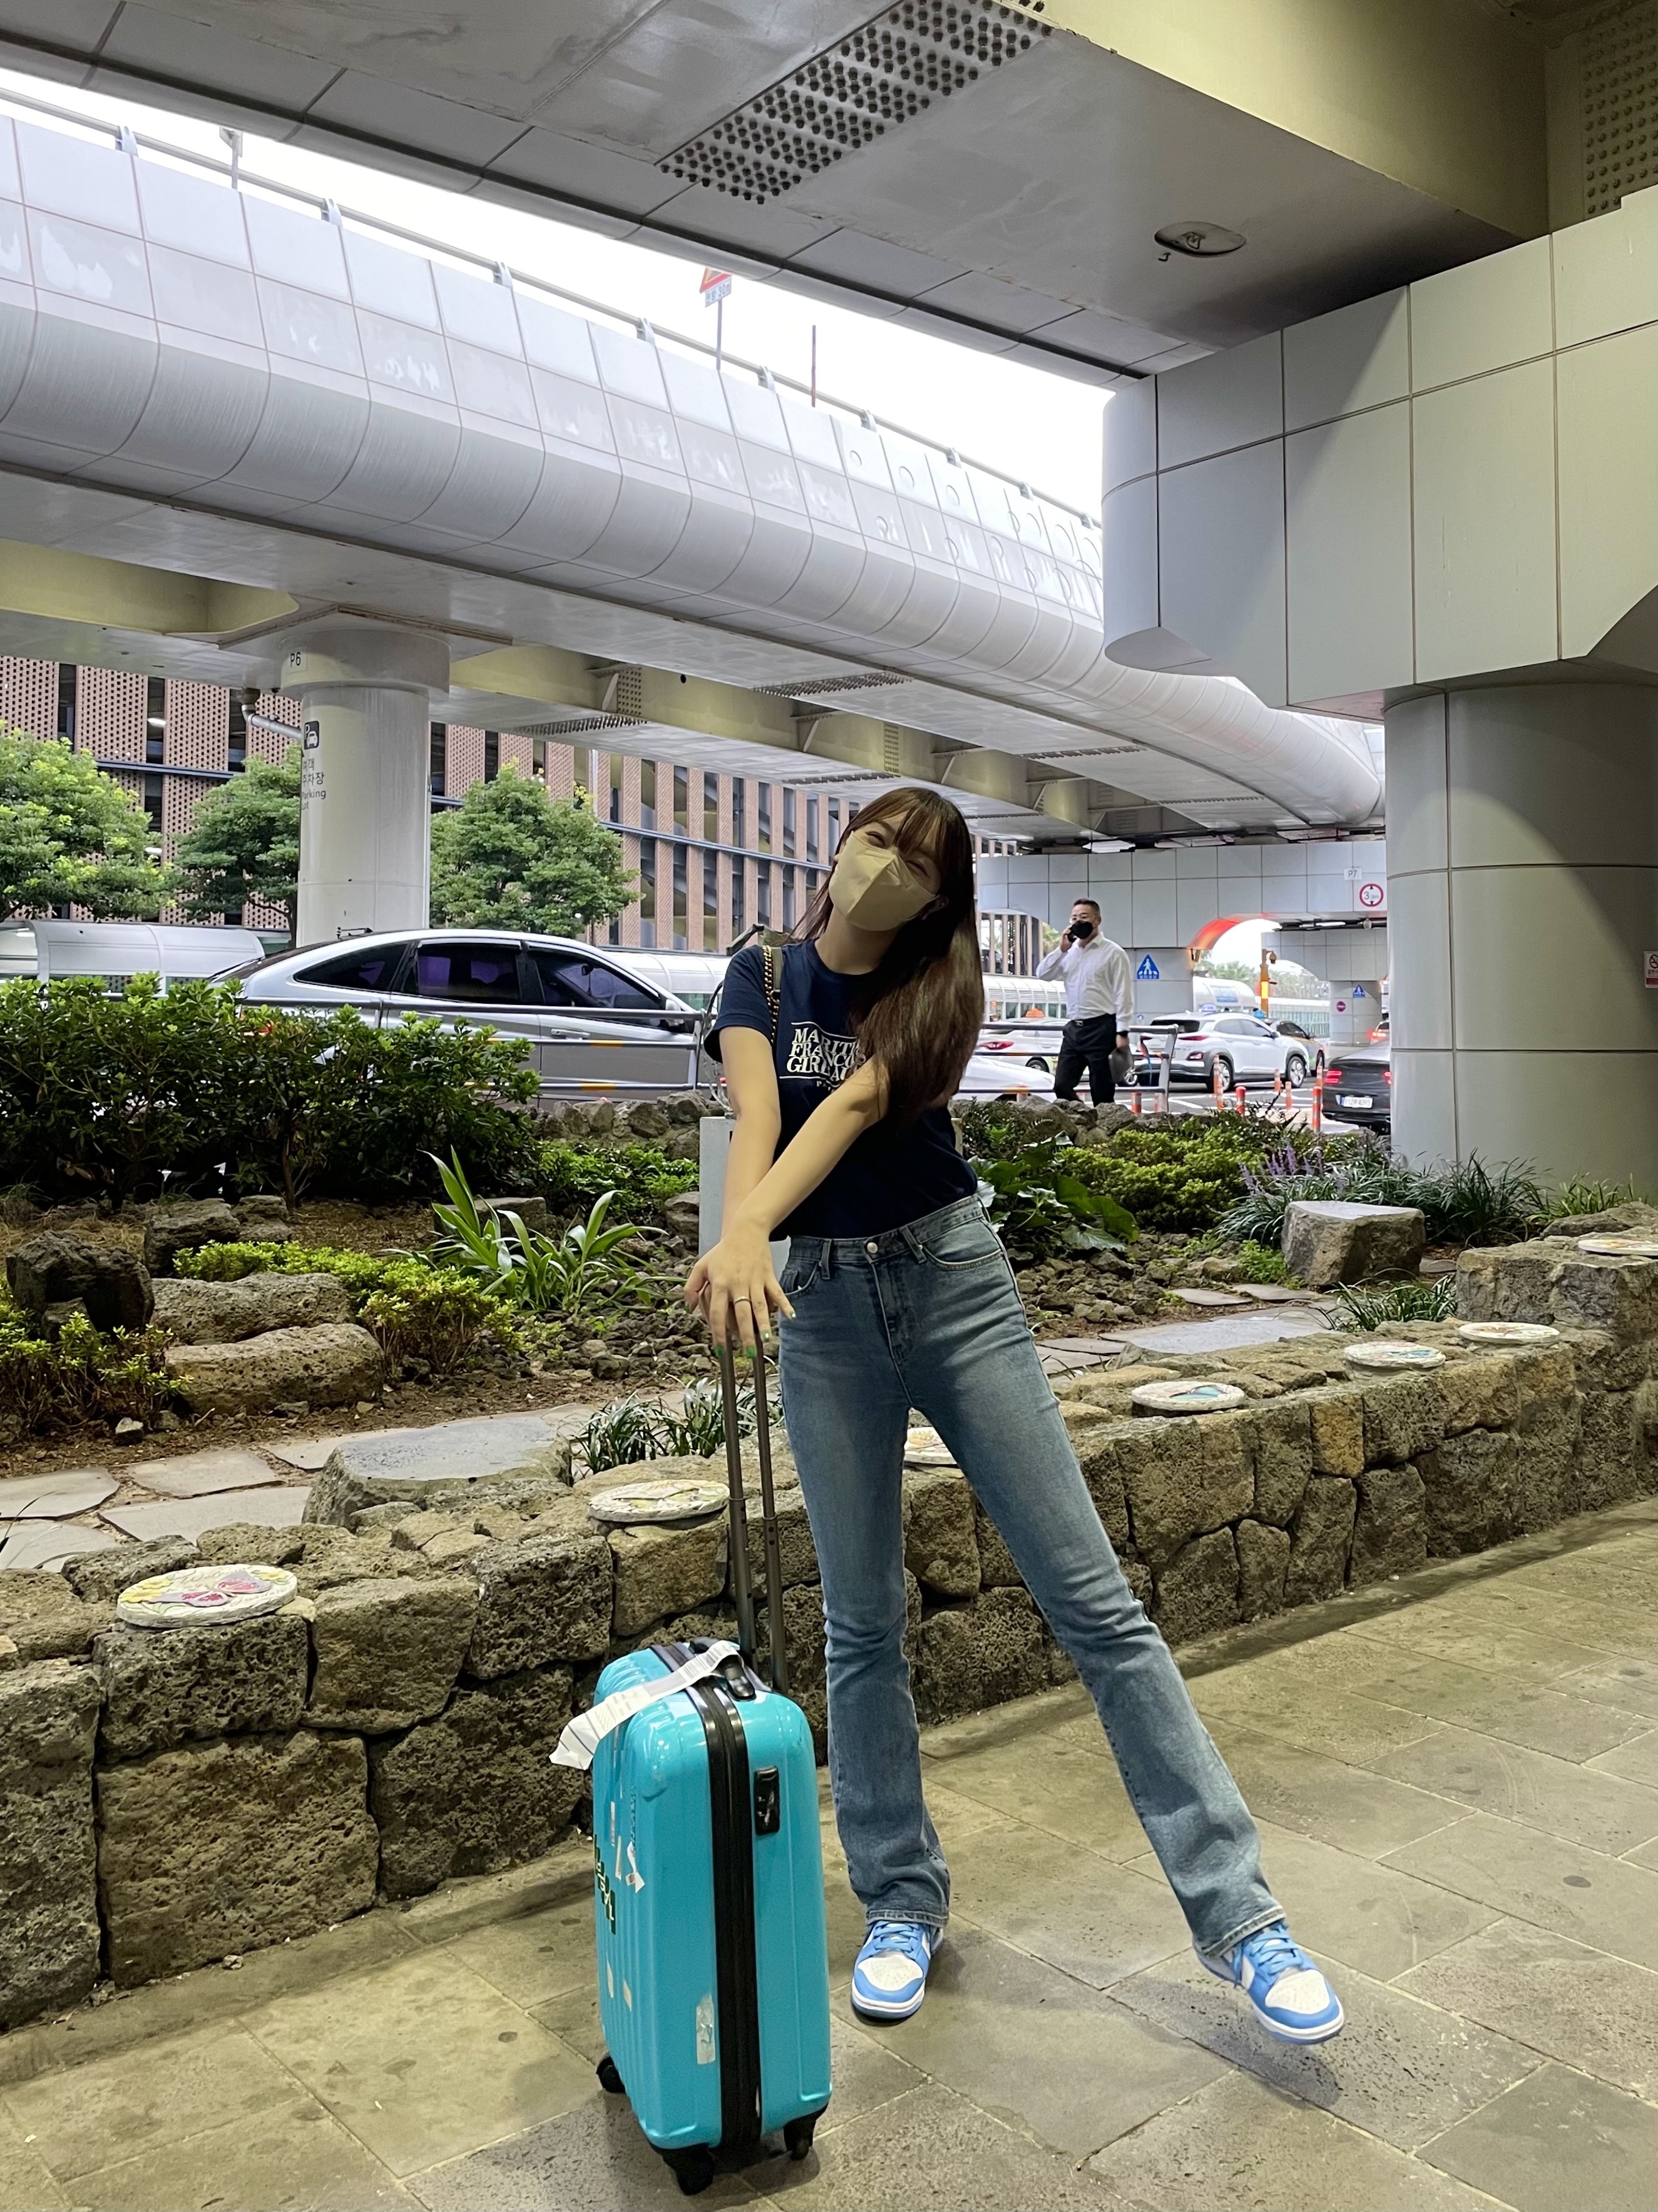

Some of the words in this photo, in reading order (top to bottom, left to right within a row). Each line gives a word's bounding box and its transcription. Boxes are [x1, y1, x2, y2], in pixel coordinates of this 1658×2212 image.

[290, 651, 301, 668] P6
[302, 772, 324, 787] 주차장
[302, 789, 326, 800] Parking
